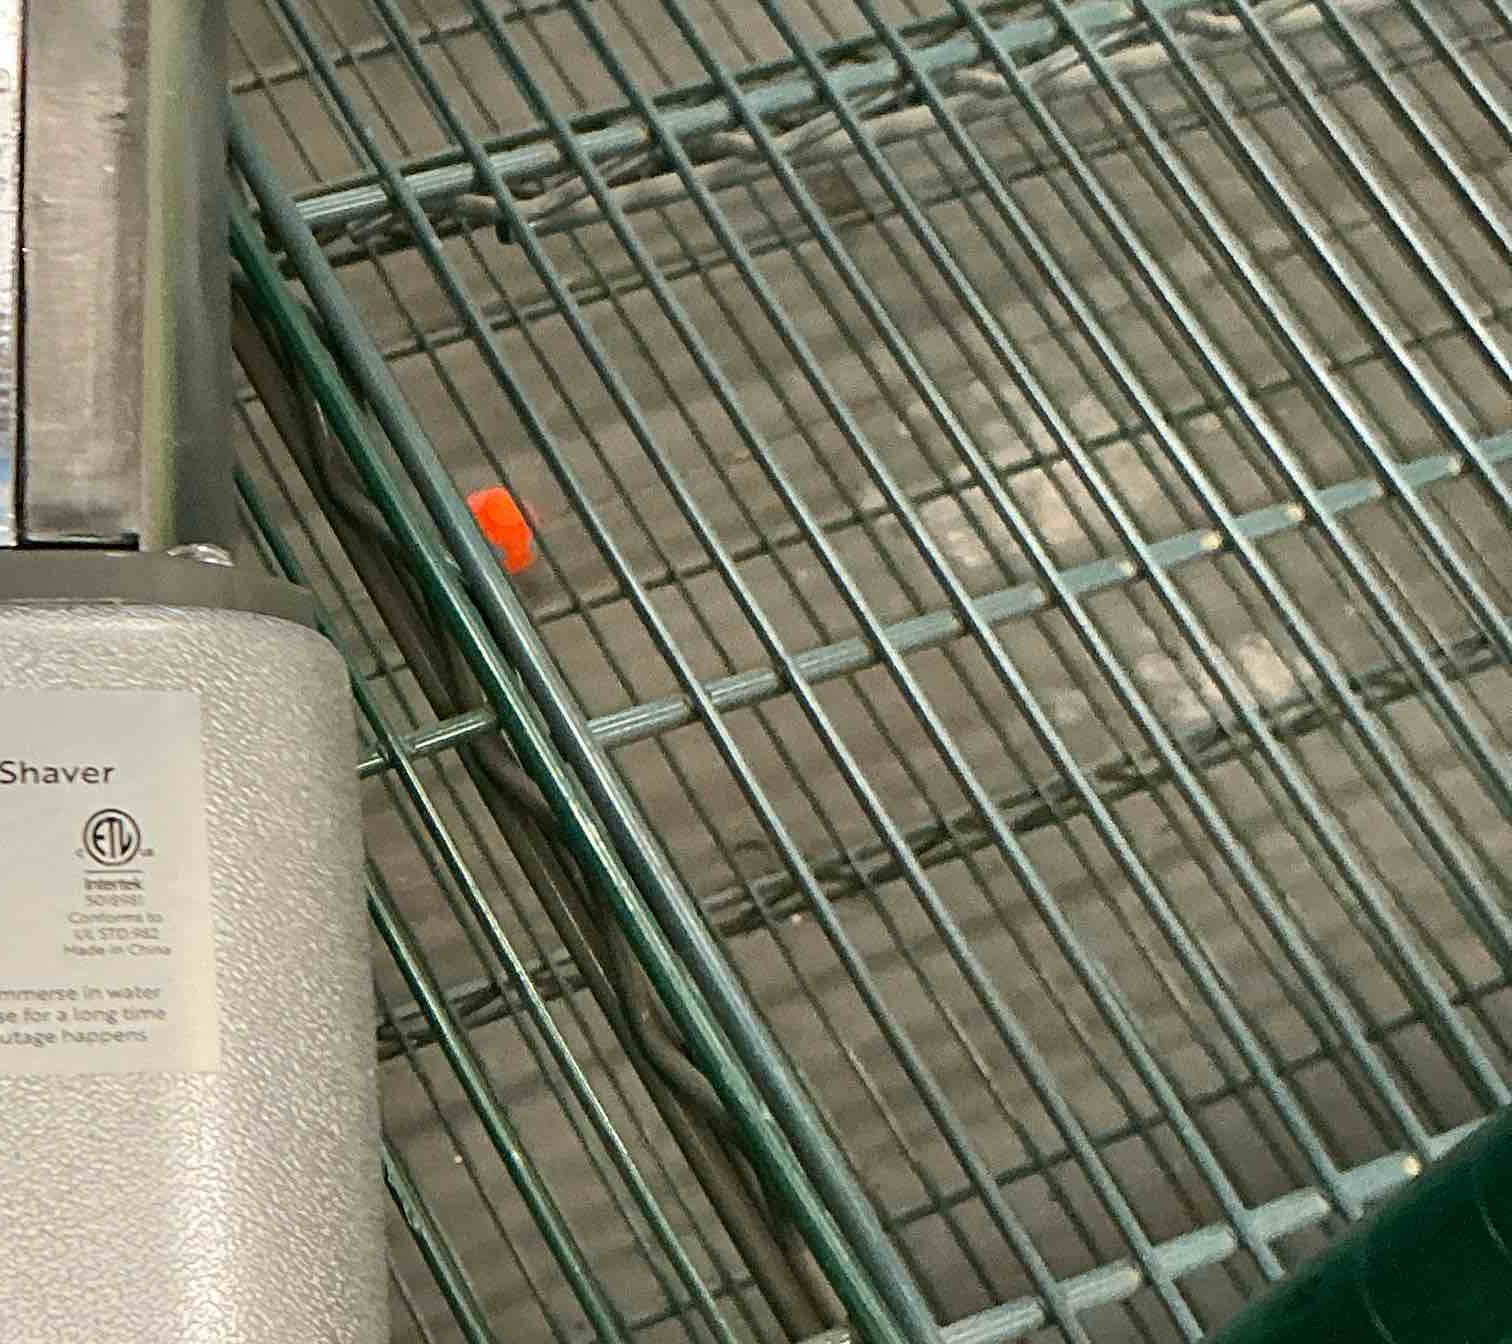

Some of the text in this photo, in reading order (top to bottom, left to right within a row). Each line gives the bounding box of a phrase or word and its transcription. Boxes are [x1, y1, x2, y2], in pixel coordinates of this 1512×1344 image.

[82, 985, 103, 1000] in
[105, 986, 161, 1001] water
[23, 1007, 52, 1023] for
[55, 1009, 68, 1022] a
[72, 1006, 119, 1025] long
[122, 1006, 168, 1022] time
[61, 1028, 149, 1046] happens
